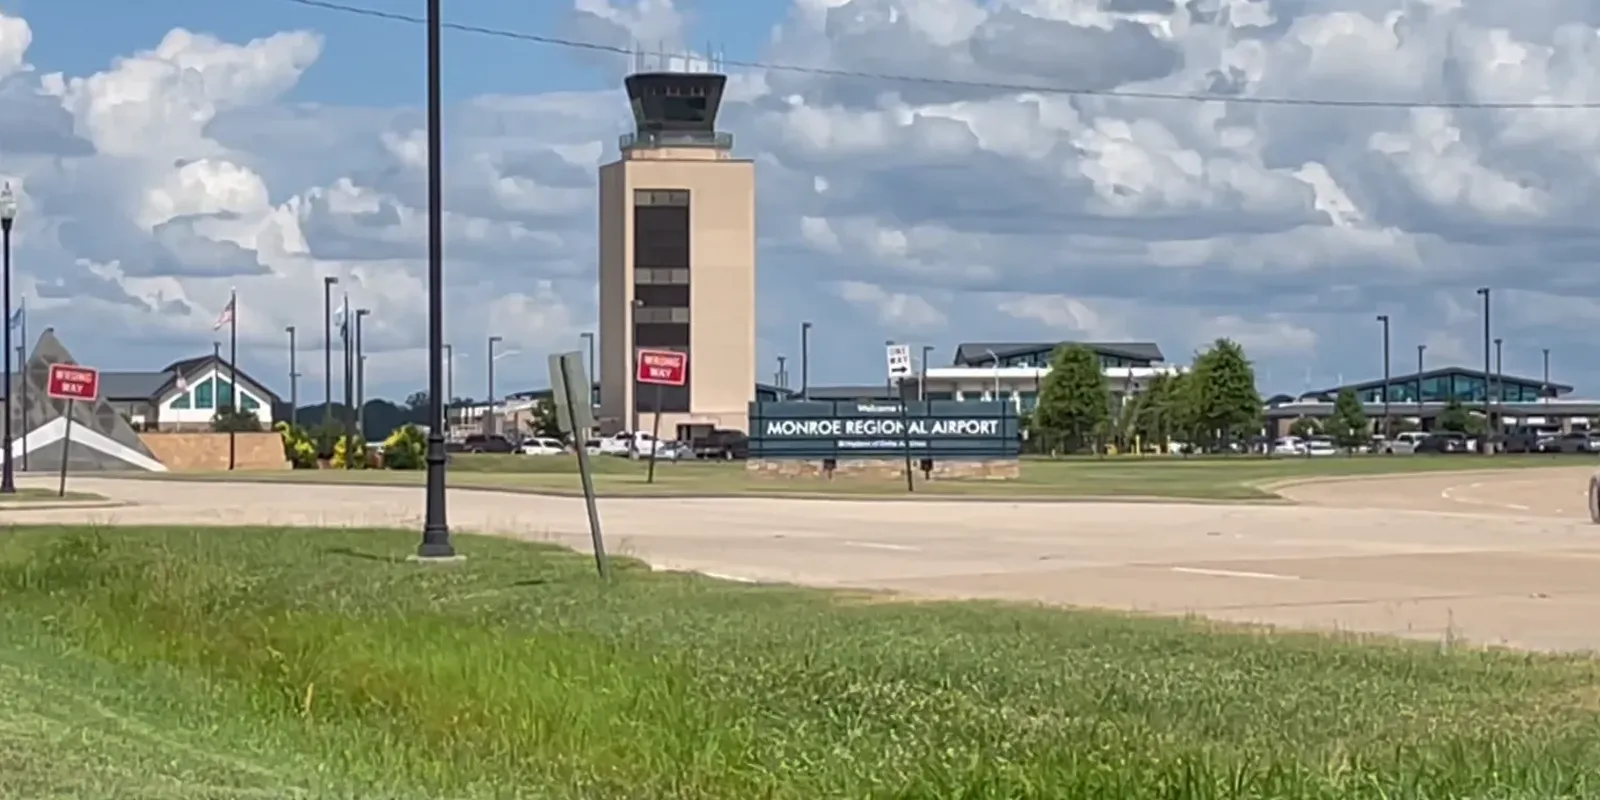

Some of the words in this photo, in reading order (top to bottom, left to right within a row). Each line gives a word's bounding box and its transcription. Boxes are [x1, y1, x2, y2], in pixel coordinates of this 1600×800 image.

[650, 367, 673, 379] WAY
[61, 382, 85, 394] WAY
[767, 421, 841, 435] MONROE
[845, 420, 928, 434] REGIONAL
[931, 420, 998, 434] AIRPORT
